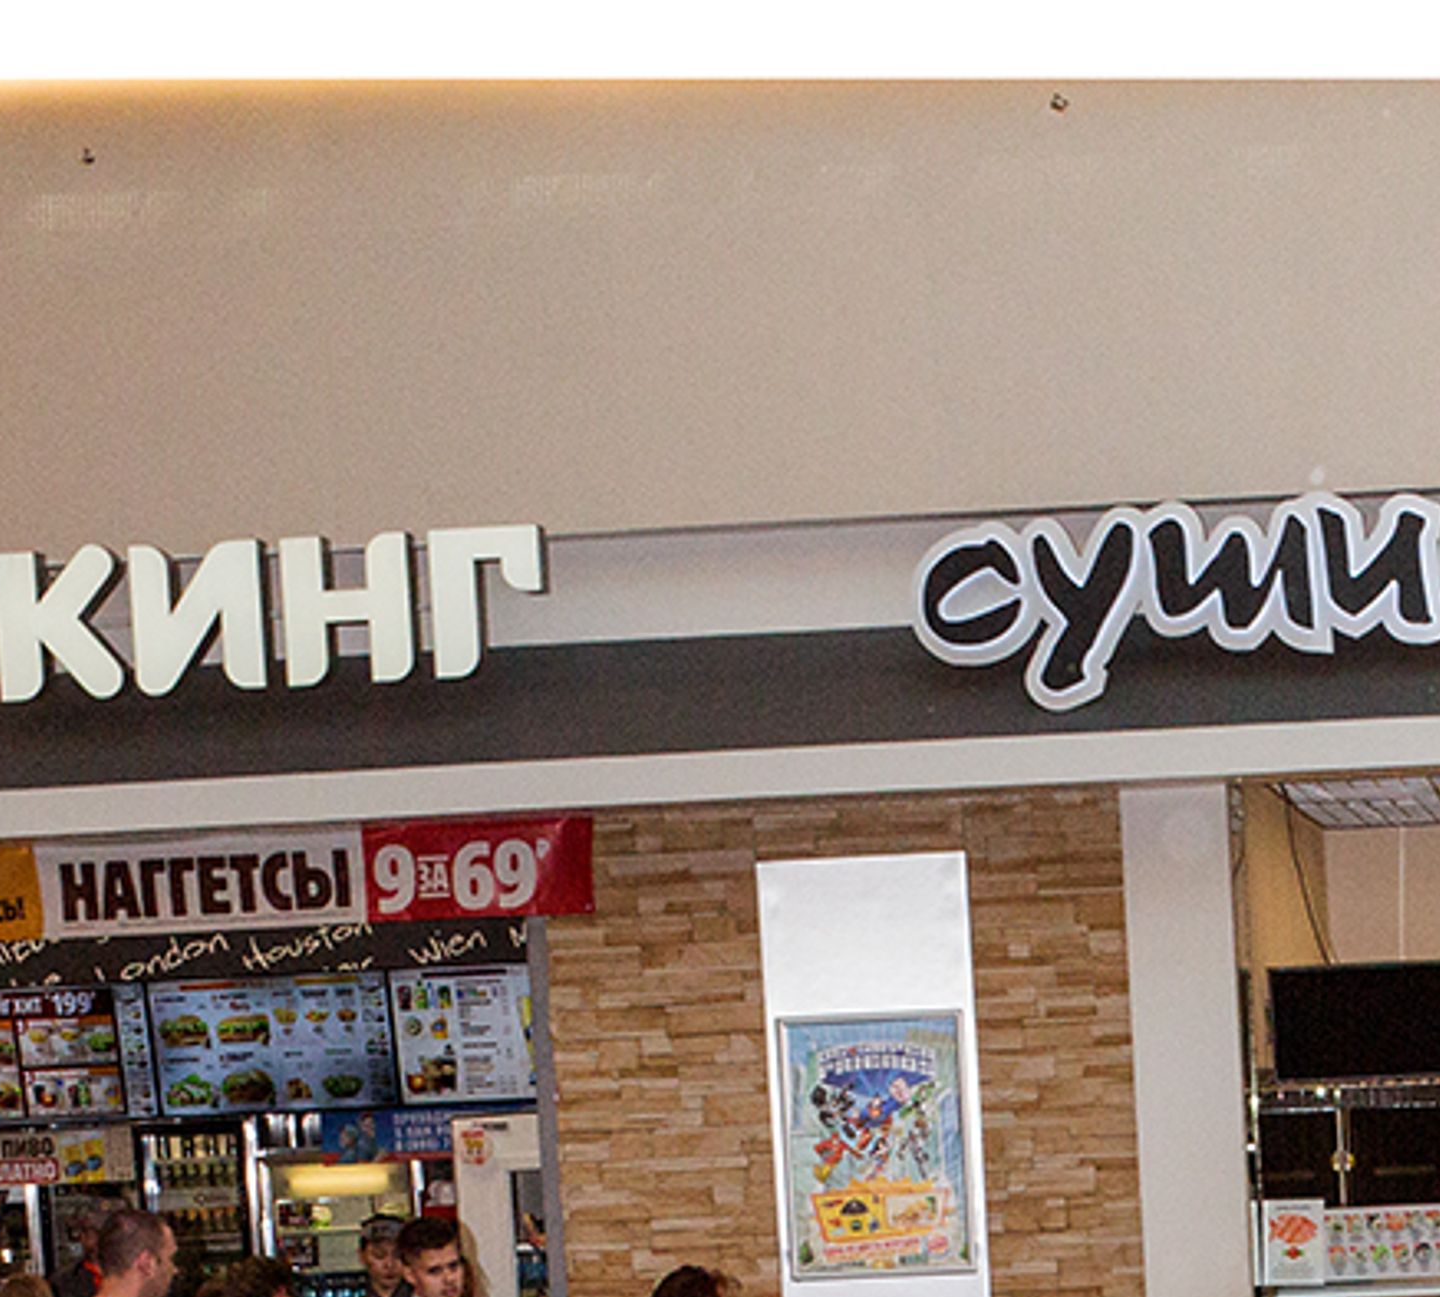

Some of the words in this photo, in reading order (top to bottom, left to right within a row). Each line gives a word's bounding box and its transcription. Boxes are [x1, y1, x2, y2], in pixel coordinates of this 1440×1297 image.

[918, 498, 1438, 694] суши
[59, 848, 352, 922] НАГГЕТСЫ
[372, 846, 415, 913] 9
[3, 1136, 55, 1158] ПИВО
